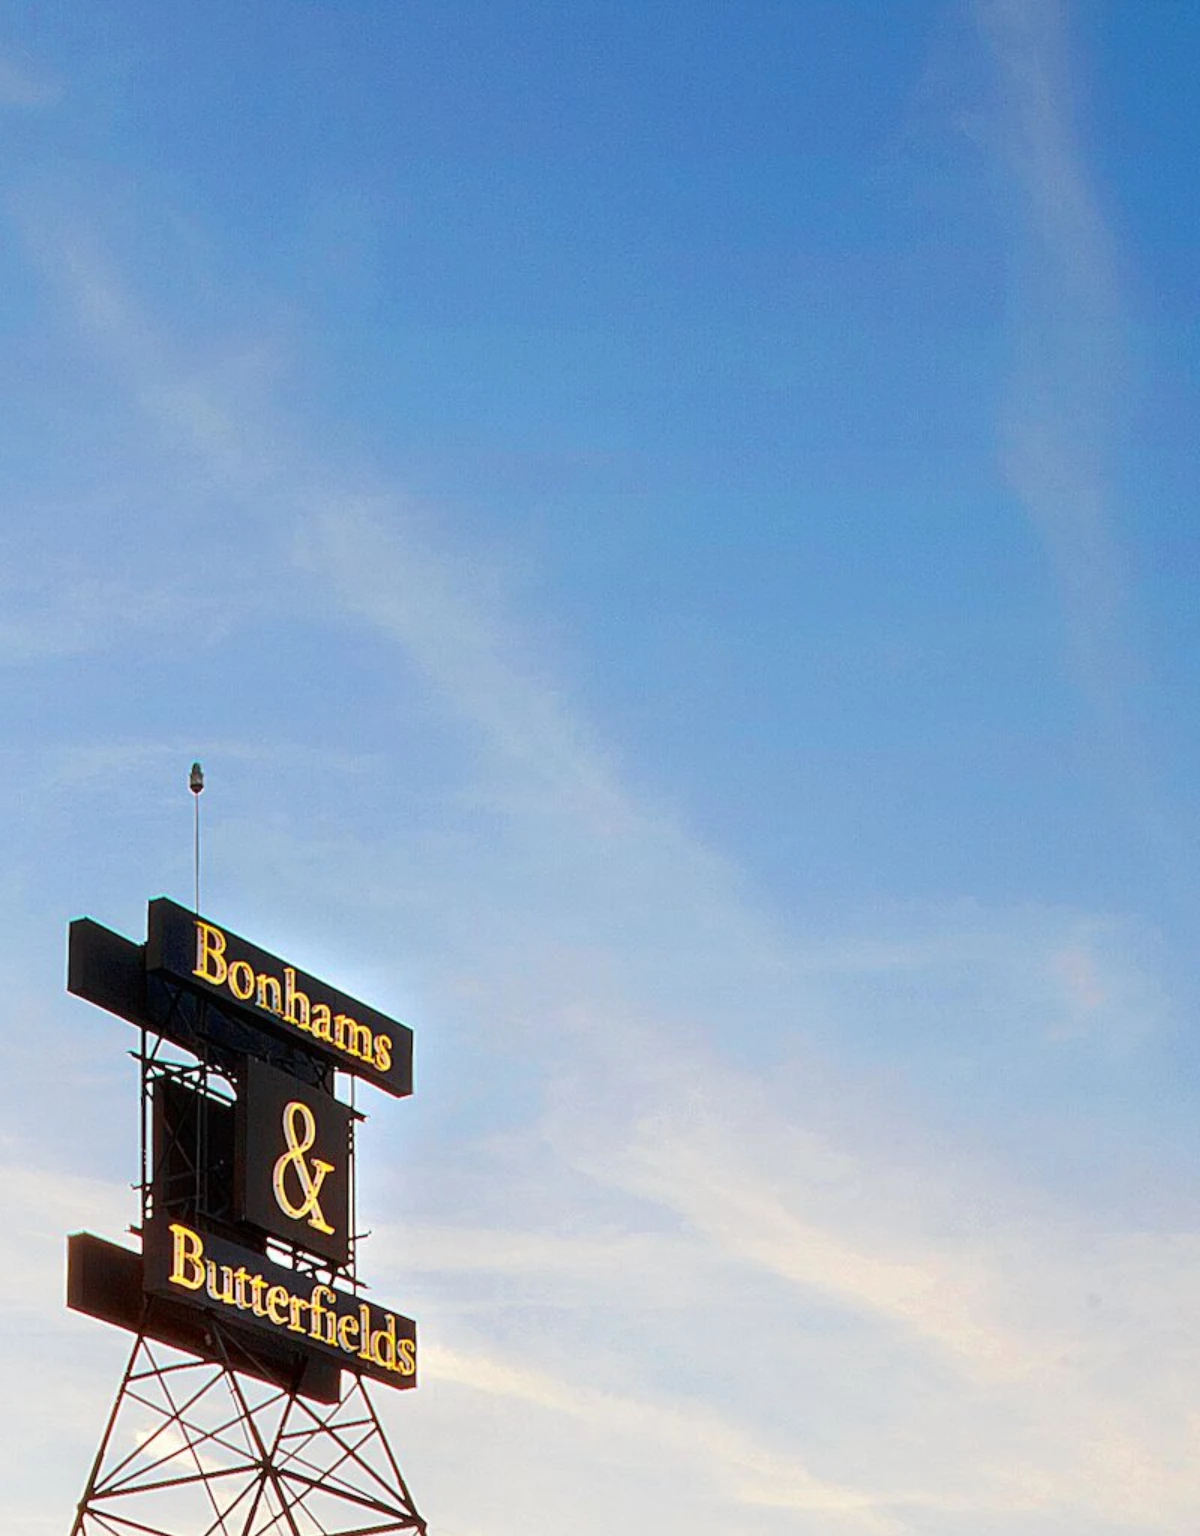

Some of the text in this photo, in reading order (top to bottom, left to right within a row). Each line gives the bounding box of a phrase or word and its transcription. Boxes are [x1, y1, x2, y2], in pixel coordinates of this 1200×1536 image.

[193, 920, 393, 1072] Bonhams
[273, 1101, 334, 1235] &
[168, 1223, 417, 1376] Butterfields
